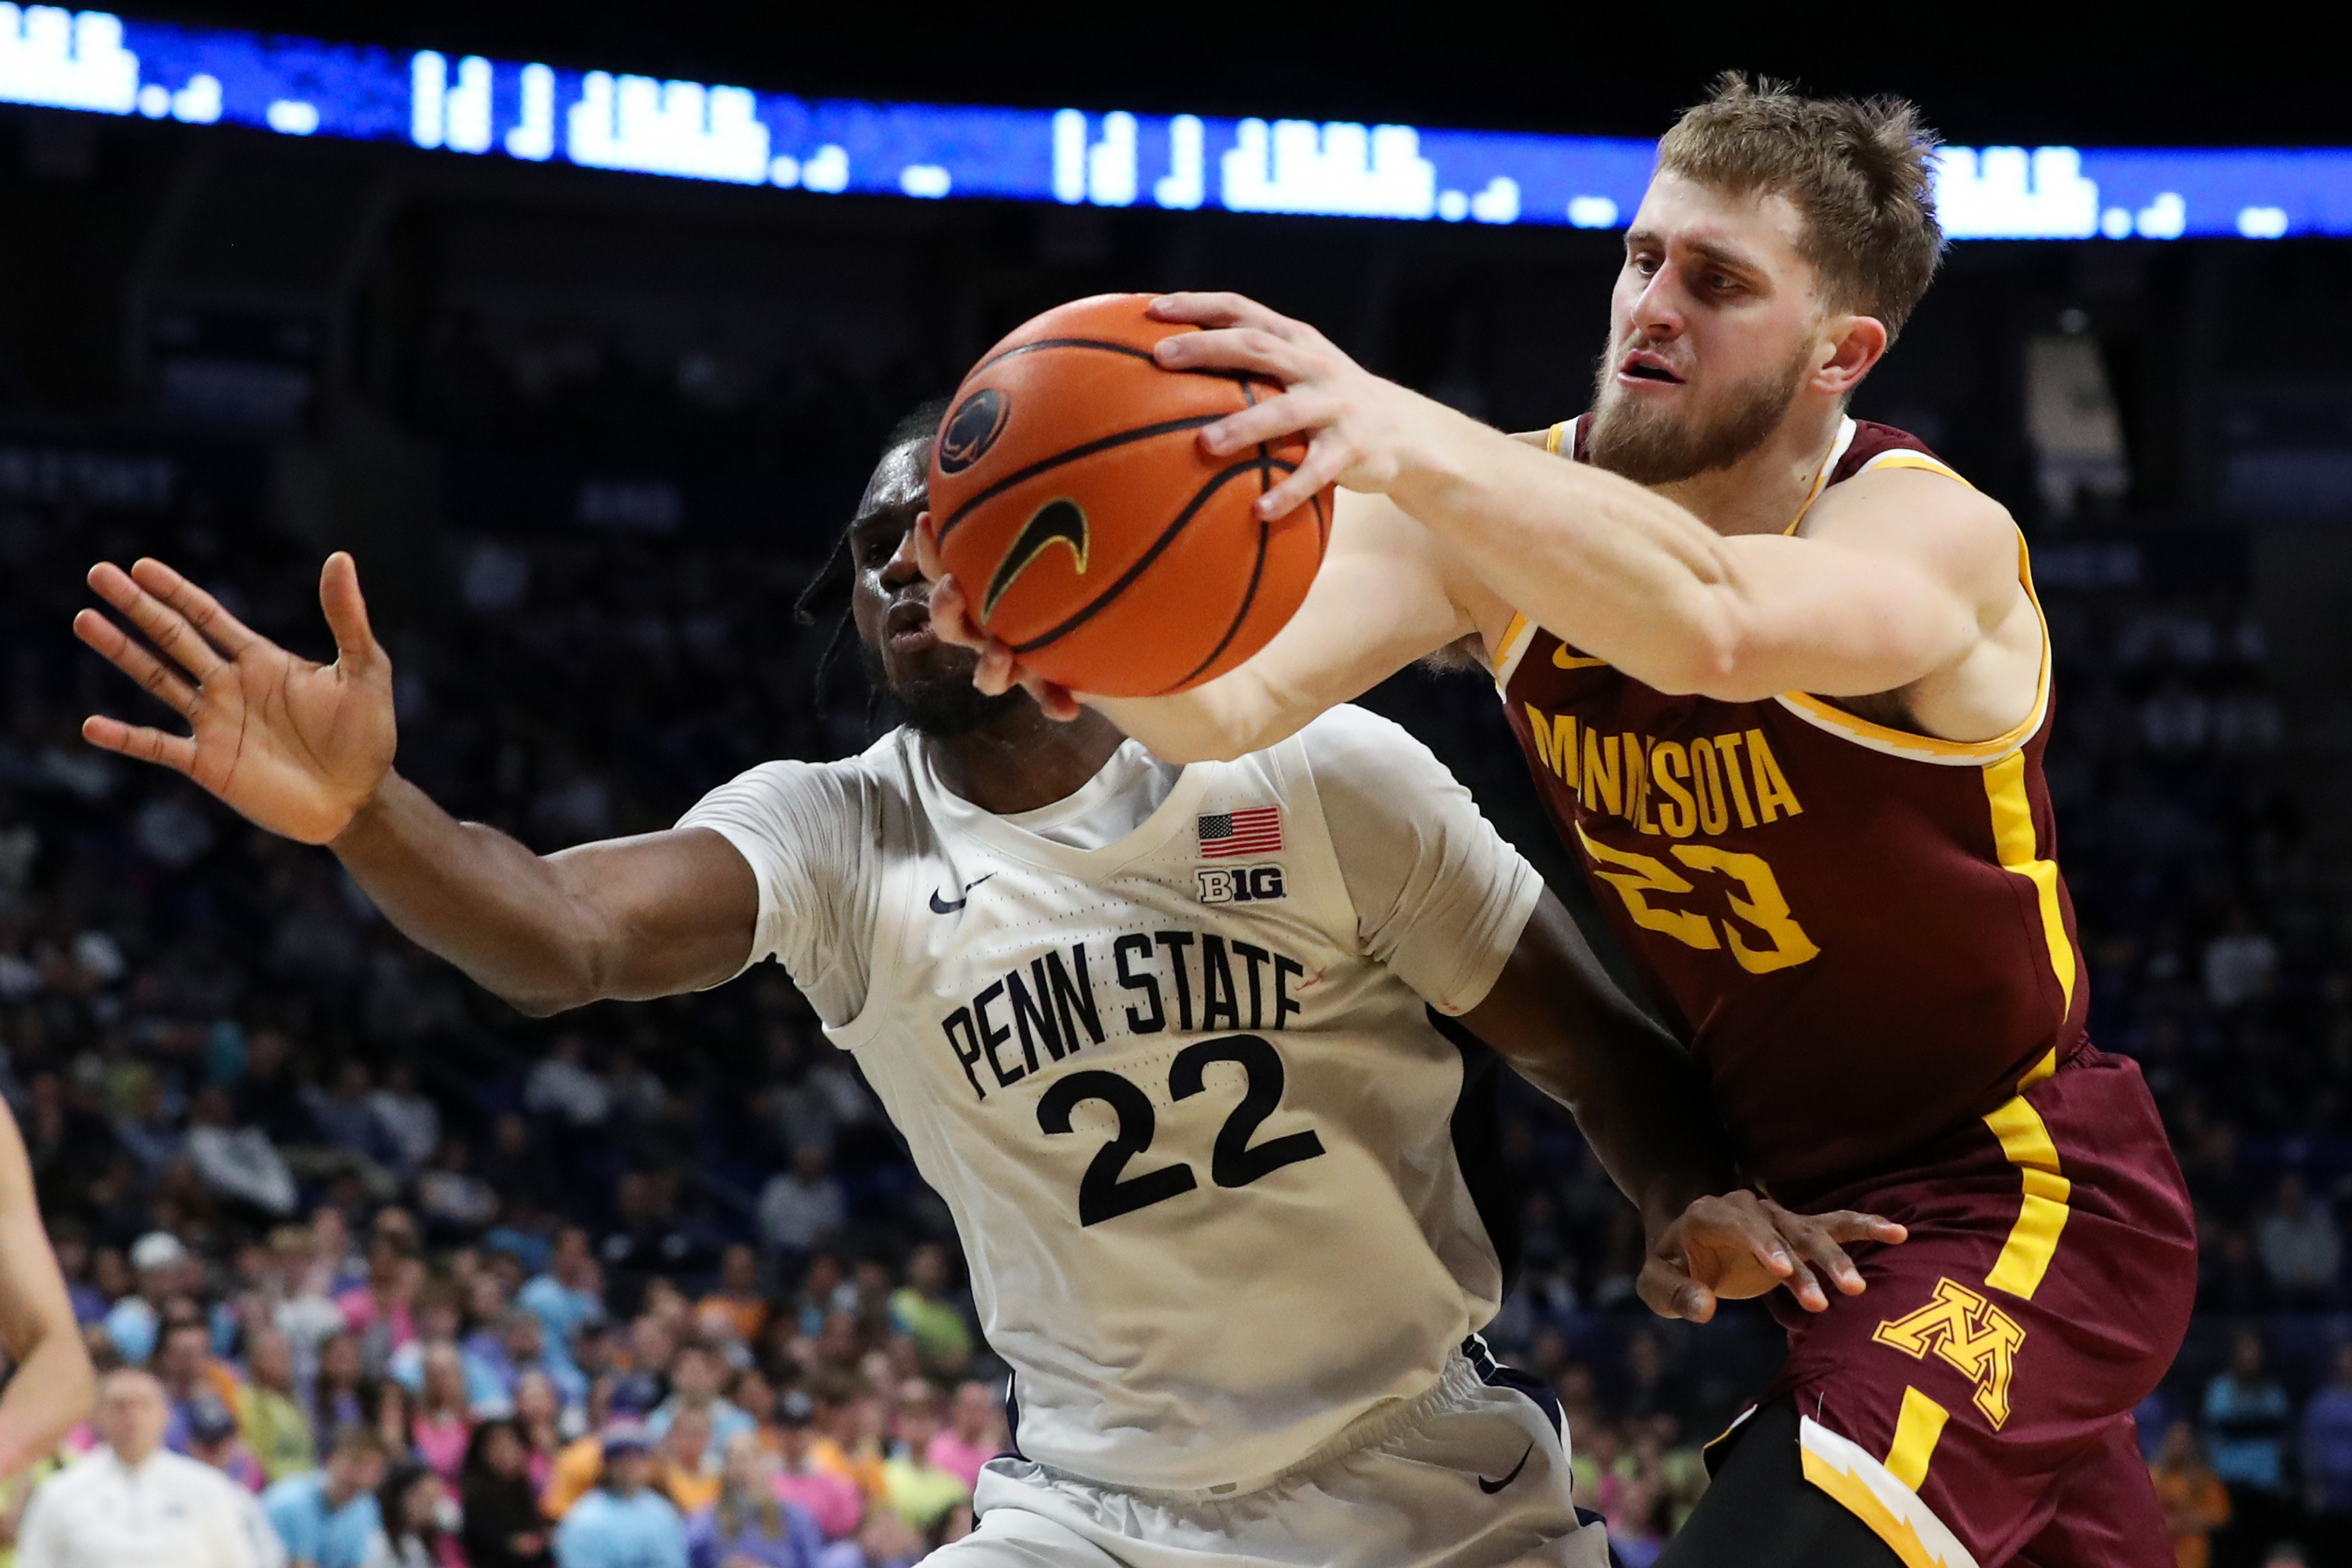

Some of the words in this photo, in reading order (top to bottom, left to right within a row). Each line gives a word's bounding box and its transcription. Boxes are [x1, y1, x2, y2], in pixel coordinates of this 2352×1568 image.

[1524, 701, 1803, 839] MNNESOTA
[1198, 868, 1284, 903] BIG
[1573, 820, 1821, 975] 23
[942, 943, 1106, 1101] PENN
[1114, 931, 1304, 1035] STATE
[1036, 1034, 1326, 1228] 22
